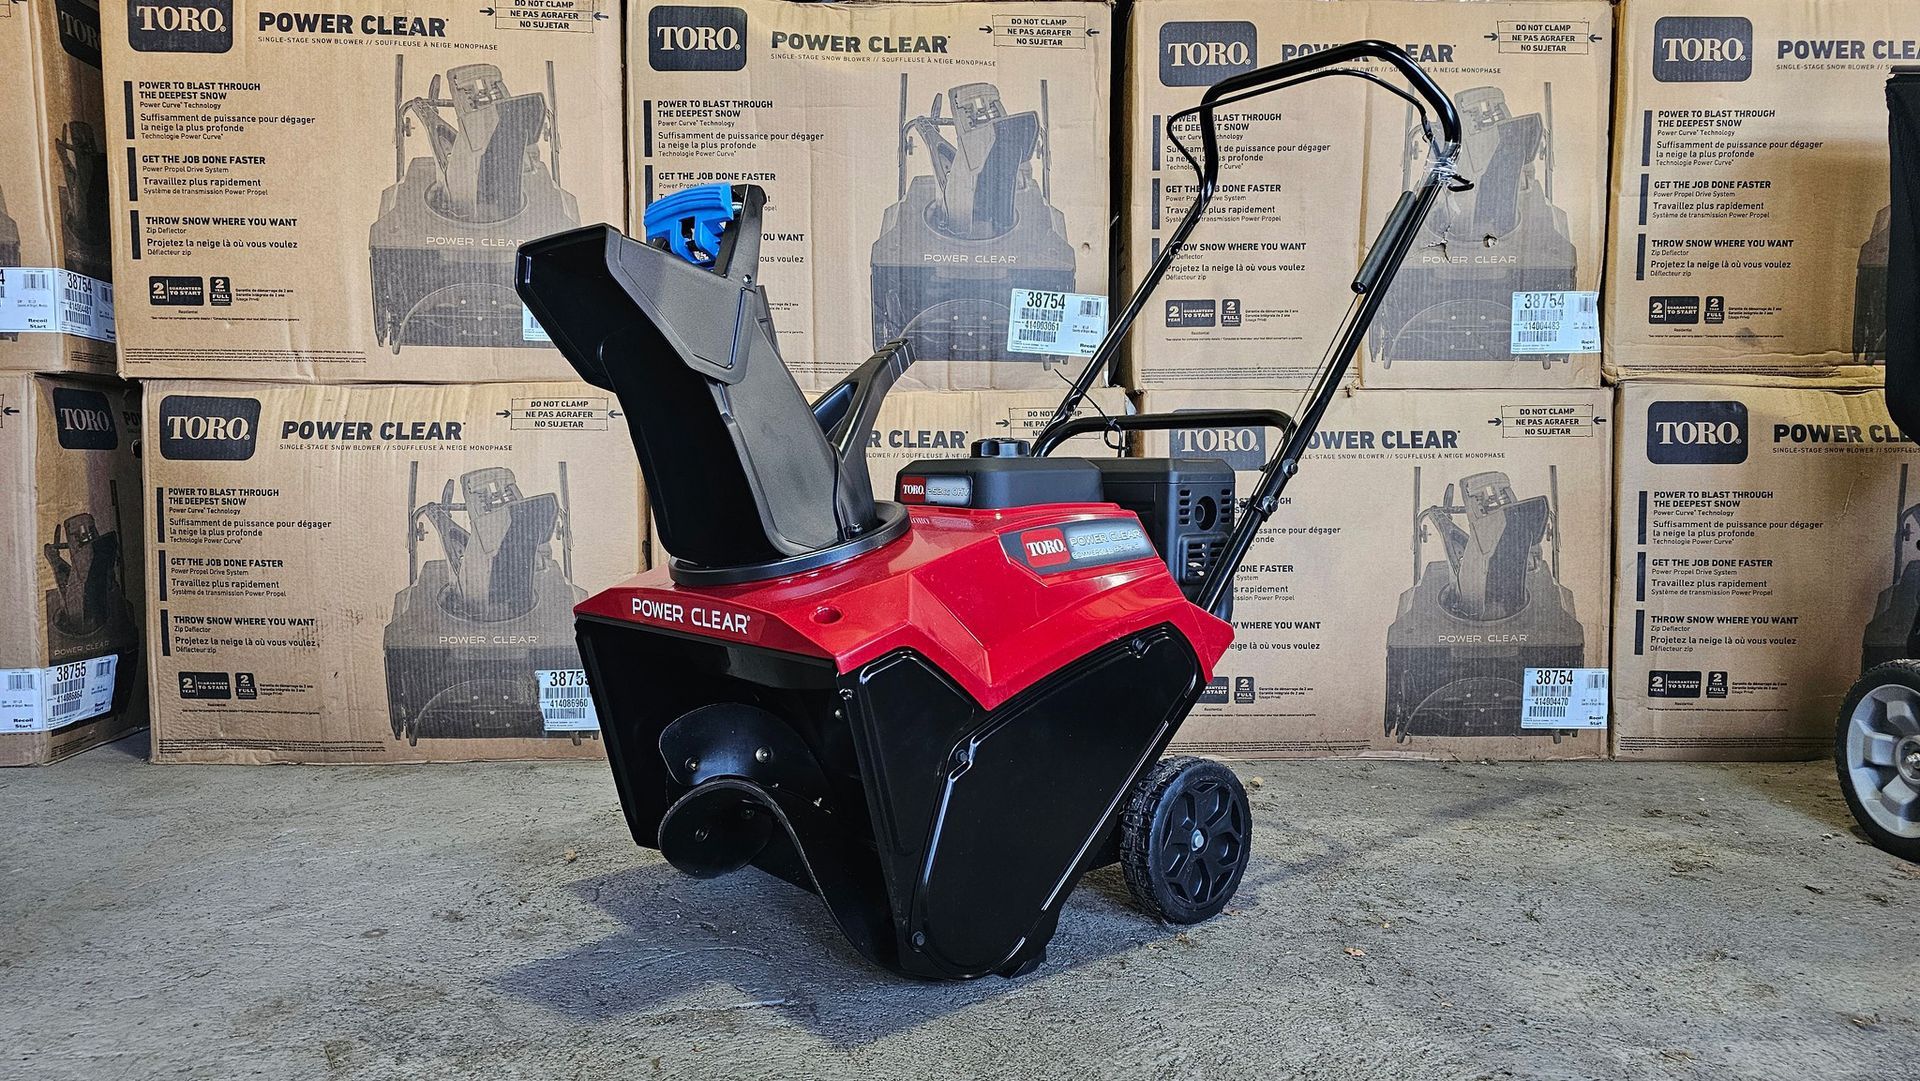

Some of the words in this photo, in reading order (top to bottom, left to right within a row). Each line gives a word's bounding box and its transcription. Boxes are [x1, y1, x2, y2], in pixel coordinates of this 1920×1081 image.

[510, 10, 520, 18] NE
[523, 11, 538, 19] PAS
[541, 12, 578, 20] AGRAFER
[259, 12, 353, 34] POWER
[361, 15, 448, 37] CLEAR
[533, 21, 569, 29] SUJETAR
[772, 31, 860, 52] POWER
[869, 36, 948, 53] CLEAR
[1778, 40, 1865, 59] POWER
[187, 82, 216, 90] BLAST
[200, 92, 227, 100] SNOW
[184, 102, 221, 110] Technology
[141, 113, 199, 121] Suffisamment
[201, 114, 211, 122] de
[214, 114, 256, 123] puissance
[280, 116, 315, 125] dégager
[151, 123, 174, 132] neige
[186, 124, 204, 132] plus
[206, 124, 244, 133] profonde
[141, 132, 179, 140] Technologie
[659, 172, 675, 180] GET
[677, 172, 694, 180] THE
[697, 172, 713, 180] JOB
[716, 172, 739, 180] DONE
[1696, 202, 1714, 210] plus
[1716, 202, 1764, 211] rapidement
[426, 236, 474, 247] POWER
[924, 254, 968, 264] POWER
[975, 255, 1017, 264] CLEAR
[1422, 255, 1468, 264] POWER
[1475, 255, 1517, 264] CLEAR
[67, 273, 92, 294] 38754
[153, 283, 164, 295] 2
[215, 279, 225, 288] 2
[1027, 291, 1066, 309] 38754
[1524, 293, 1564, 309] 38754
[282, 421, 373, 439] POWER
[380, 422, 461, 439] CLEAR
[1774, 424, 1864, 443] POWER
[889, 430, 965, 449] CLEAR
[1307, 432, 1374, 449] OWER
[1382, 431, 1456, 449] CLEAR
[197, 488, 207, 496] TO
[210, 488, 236, 496] BLAST
[1070, 532, 1109, 548] POWER
[1109, 528, 1143, 543] CLEAR
[632, 597, 685, 624] POWER
[691, 607, 749, 635] CLEAR
[439, 636, 486, 645] POWER
[493, 636, 538, 644] CLEAR
[1438, 635, 1481, 643] POWER
[1488, 634, 1526, 642] CLEAR
[57, 662, 87, 682] 38755
[1536, 670, 1574, 685] 38754
